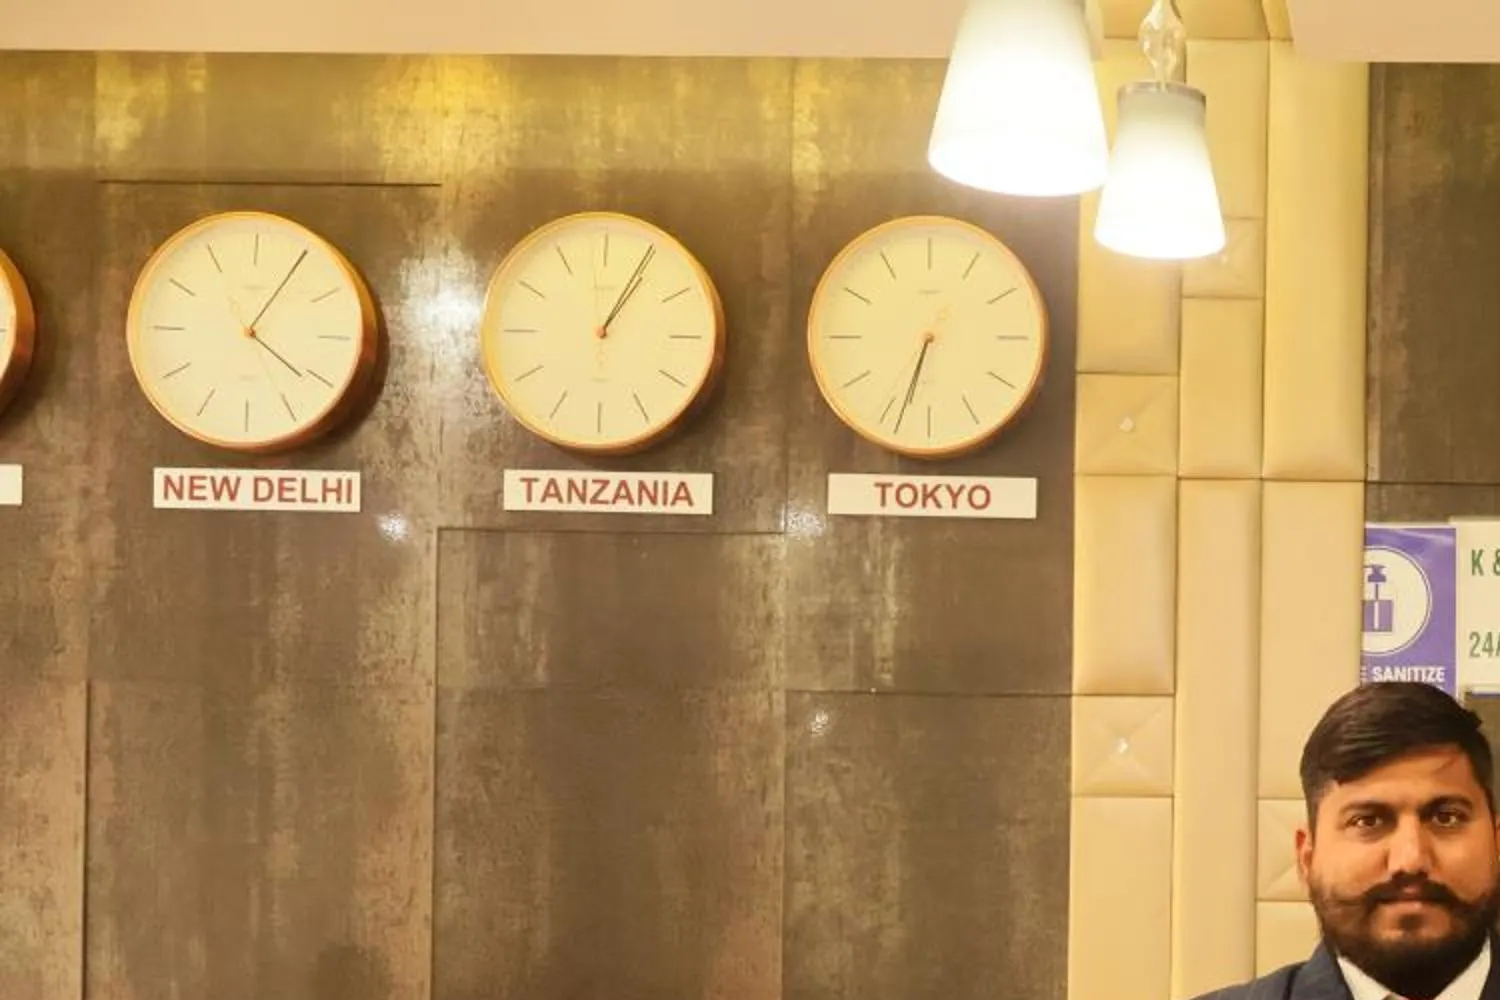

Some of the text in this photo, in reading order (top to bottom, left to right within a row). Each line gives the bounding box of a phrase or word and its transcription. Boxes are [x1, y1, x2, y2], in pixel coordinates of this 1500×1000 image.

[163, 474, 352, 504] NEW DELHI
[520, 477, 694, 507] TANZANIA
[873, 482, 991, 510] TOKYO
[1470, 549, 1485, 576] K
[1372, 665, 1446, 682] SANITIZE
